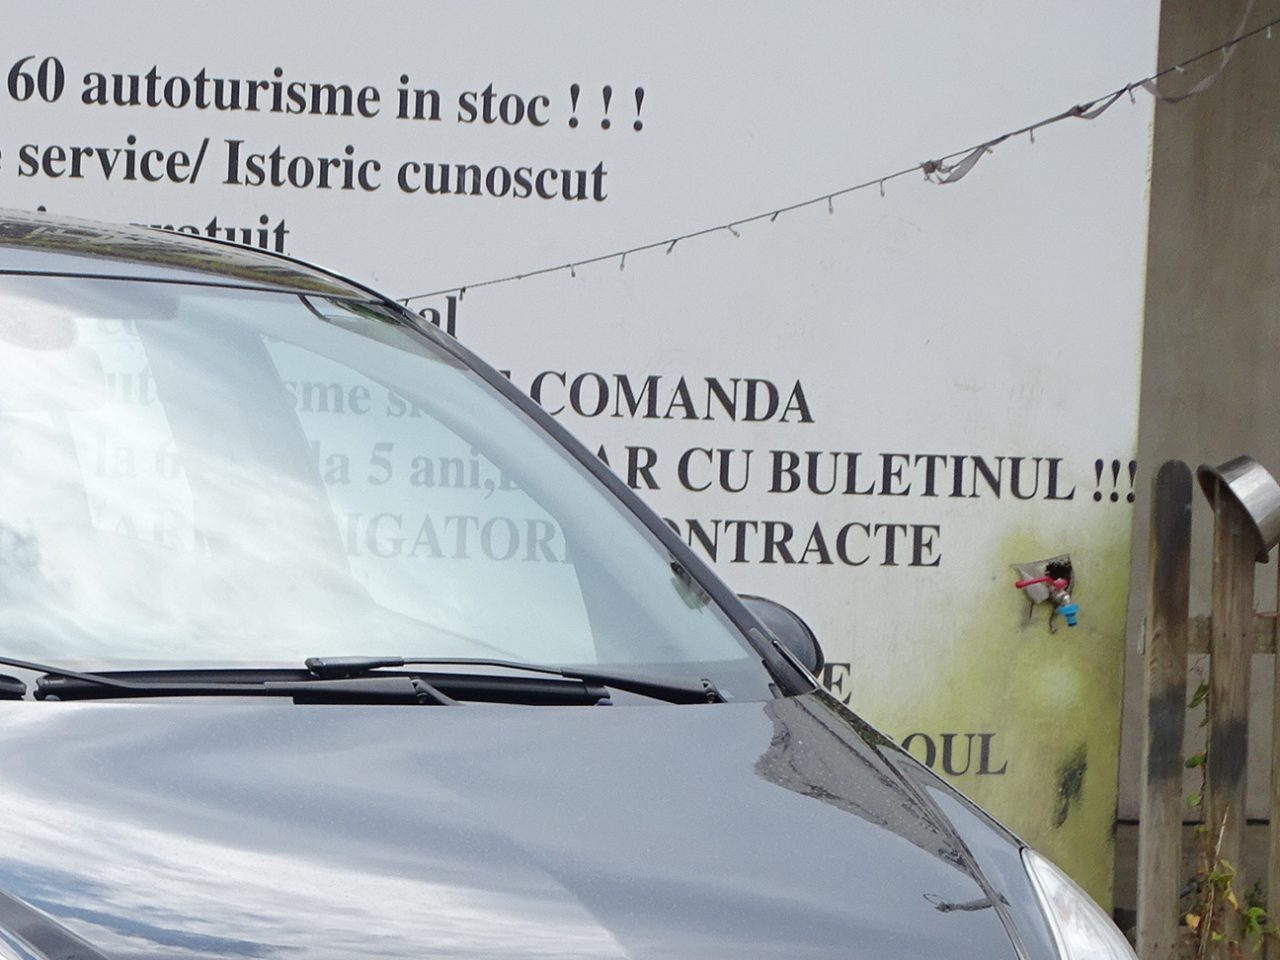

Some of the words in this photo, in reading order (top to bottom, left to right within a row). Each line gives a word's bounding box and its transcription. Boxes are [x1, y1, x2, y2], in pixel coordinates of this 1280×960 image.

[7, 56, 65, 103] 60
[81, 65, 381, 118] autoturisme
[396, 74, 441, 121] in
[457, 83, 550, 127] stoc
[18, 134, 210, 184] service/
[223, 139, 381, 192] Istoric
[397, 148, 607, 202] cunoscut
[530, 370, 816, 425] COMANDA
[366, 442, 395, 486] 5
[677, 447, 754, 493] CU
[767, 450, 1076, 502] BULETINUL
[662, 517, 942, 568] NTRACTE
